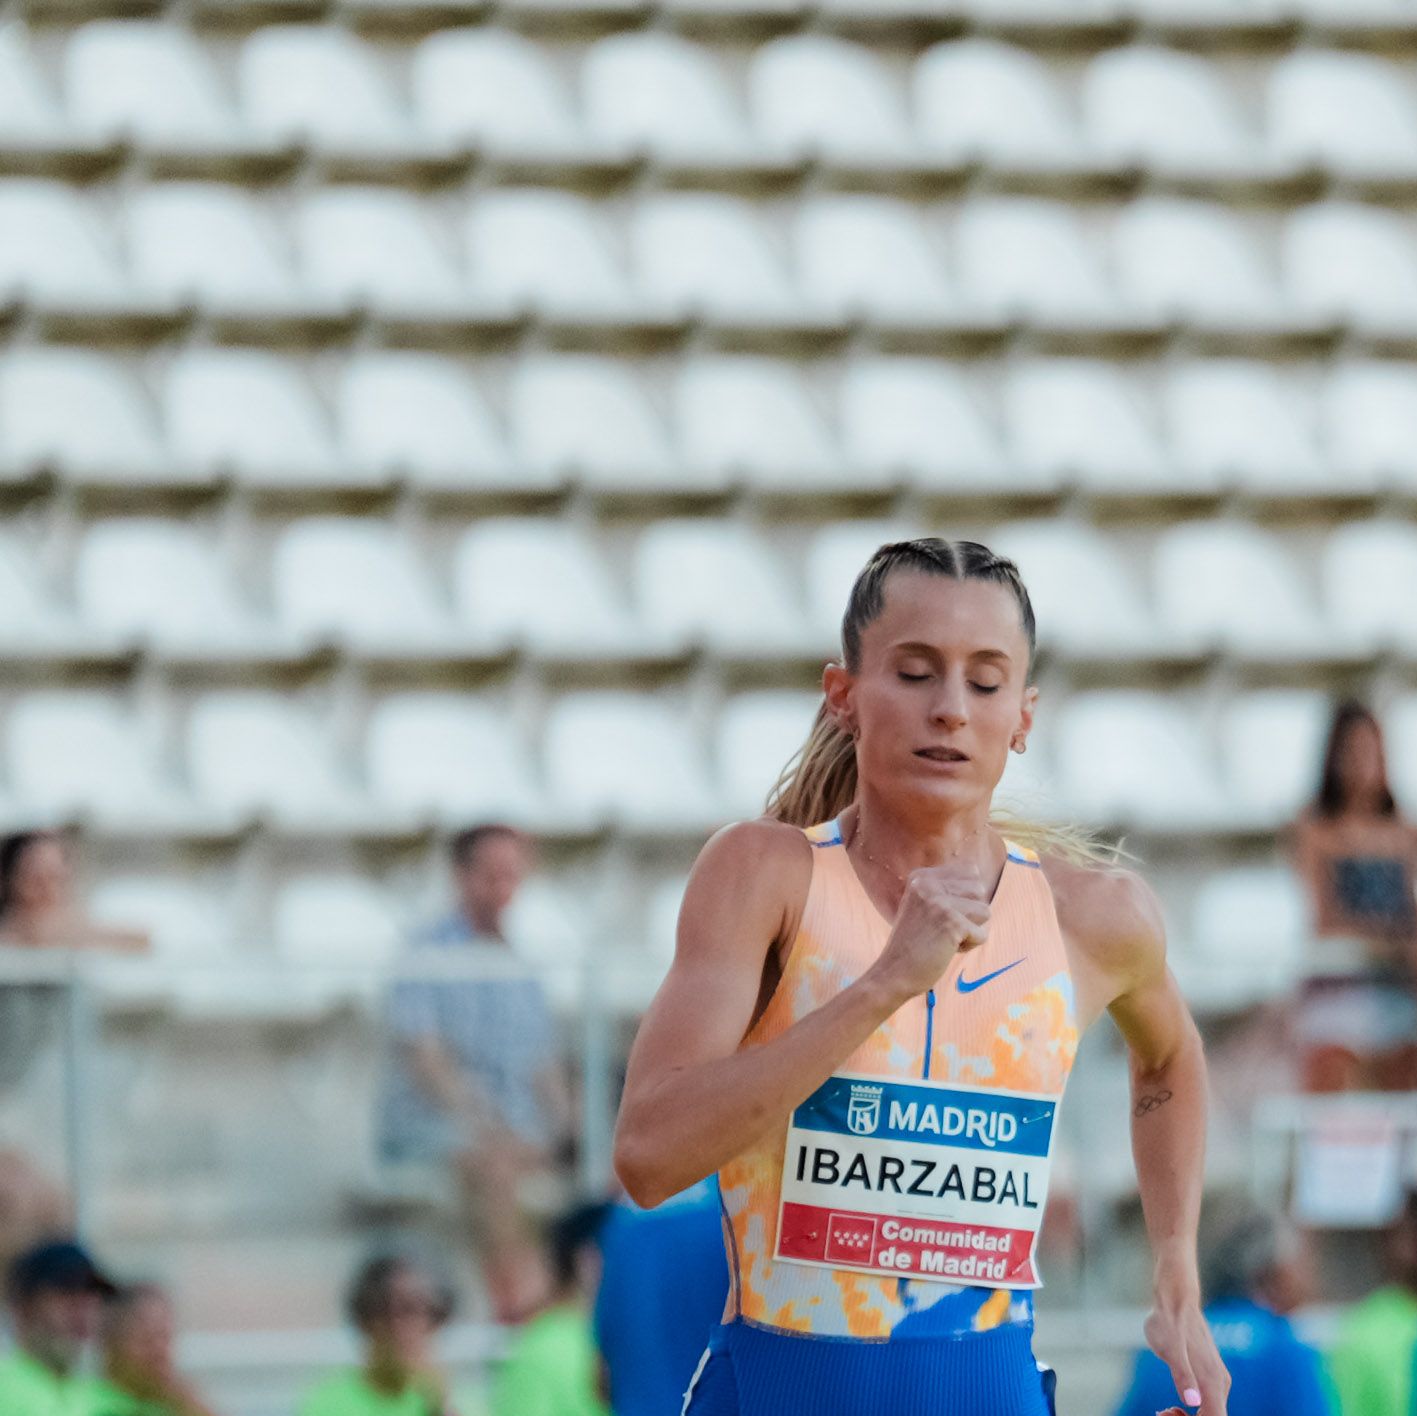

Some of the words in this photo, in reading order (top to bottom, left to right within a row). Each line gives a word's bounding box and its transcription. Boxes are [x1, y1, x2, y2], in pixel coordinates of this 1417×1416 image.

[888, 1100, 1018, 1148] MADRID
[796, 1145, 1039, 1209] IBARZABAL
[881, 1220, 1011, 1252] Comunidad
[878, 1246, 912, 1269] de
[919, 1250, 1007, 1279] Madrid
